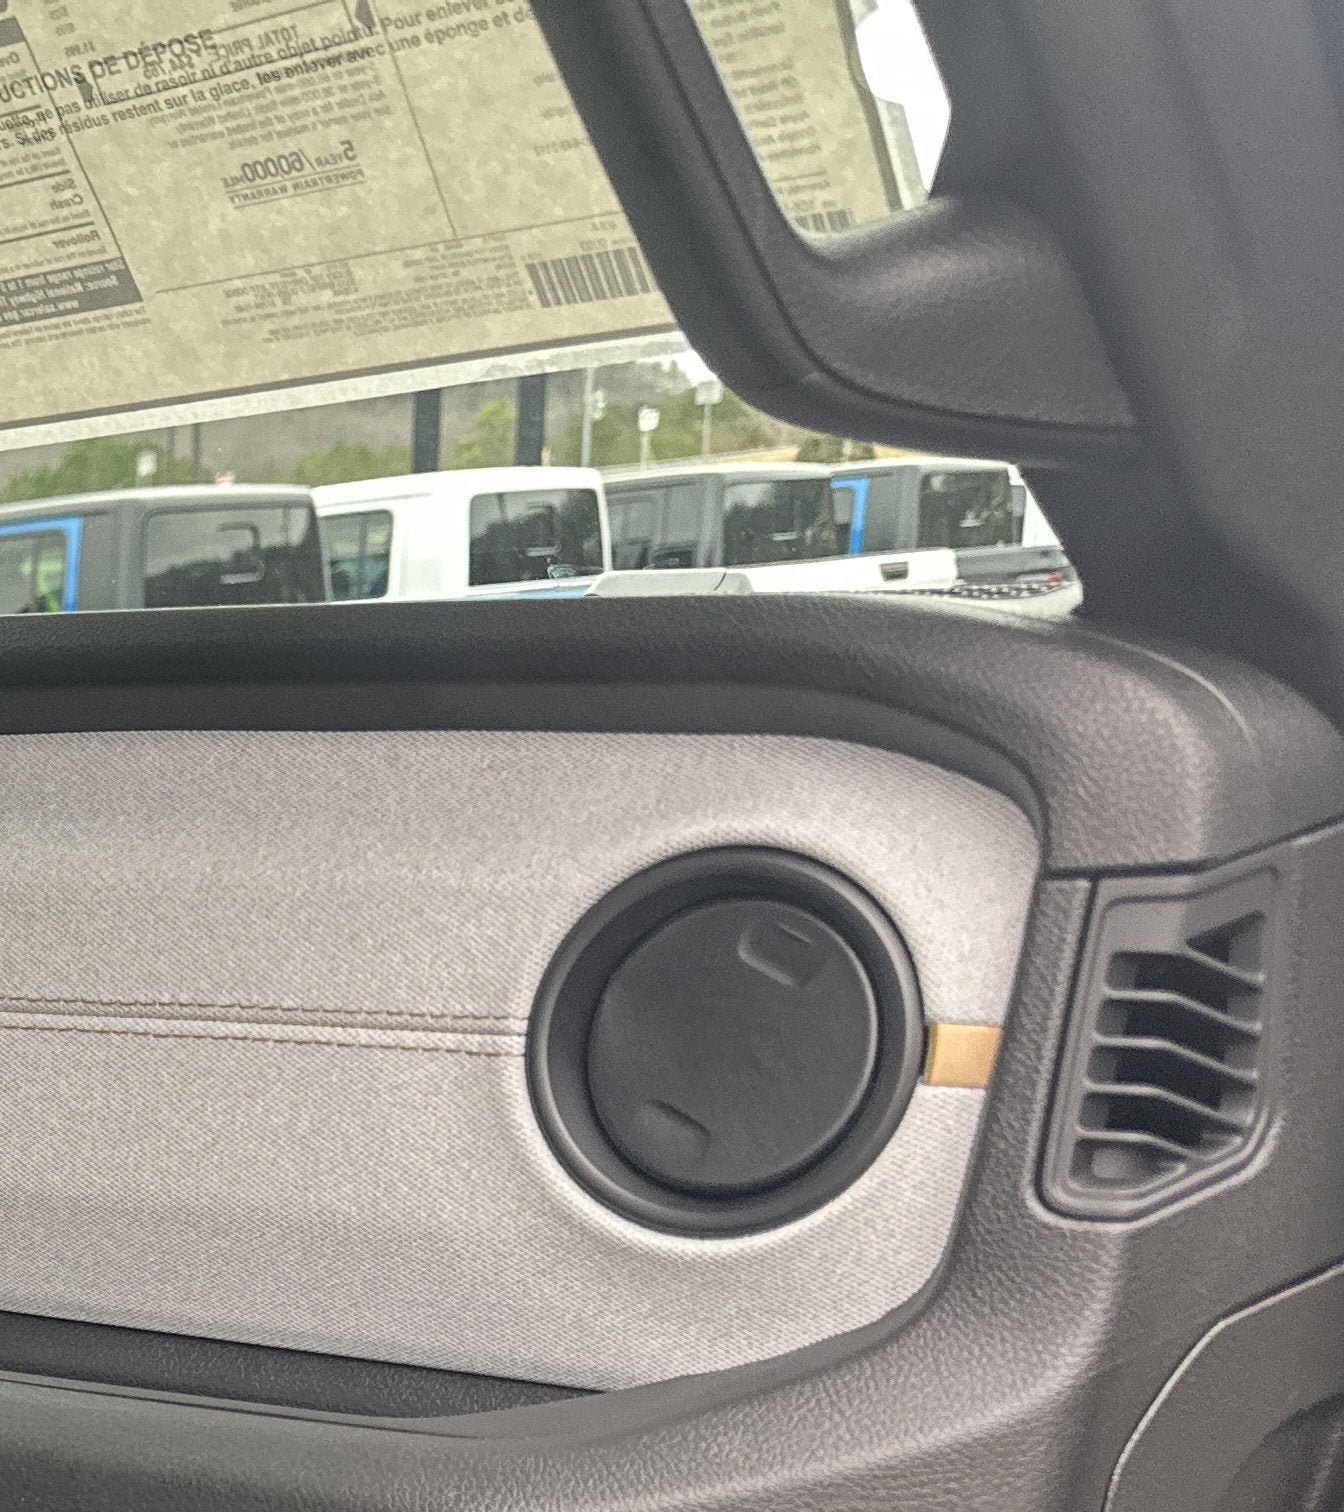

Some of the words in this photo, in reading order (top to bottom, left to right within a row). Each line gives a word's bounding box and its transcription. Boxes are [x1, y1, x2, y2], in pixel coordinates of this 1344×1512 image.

[87, 52, 122, 80] DE
[162, 91, 188, 110] sur
[189, 84, 208, 102] la
[422, 15, 490, 48] éponge
[490, 11, 511, 29] et
